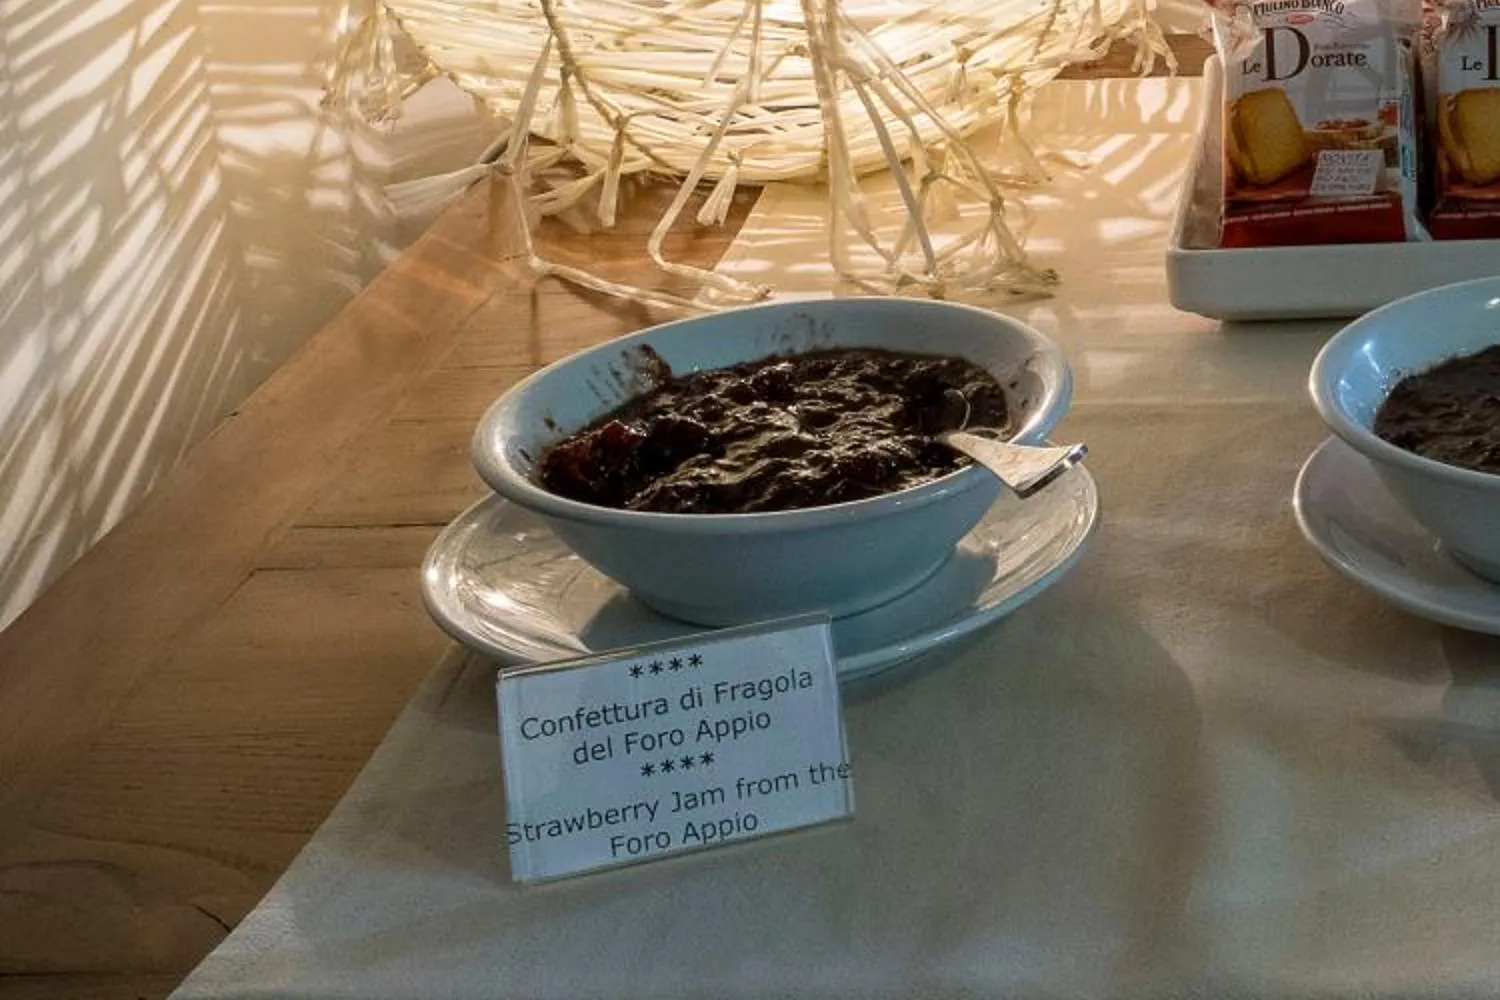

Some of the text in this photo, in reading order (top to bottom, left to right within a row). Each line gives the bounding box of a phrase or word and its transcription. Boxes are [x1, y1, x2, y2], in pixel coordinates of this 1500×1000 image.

[1242, 25, 1368, 82] Le Dorate
[1461, 55, 1483, 71] Le
[520, 669, 814, 741] Confettura di Fragola
[573, 710, 772, 765] del Foro Appio
[506, 761, 852, 845] Strawberry Jam from the
[610, 811, 759, 857] Foro Appio
